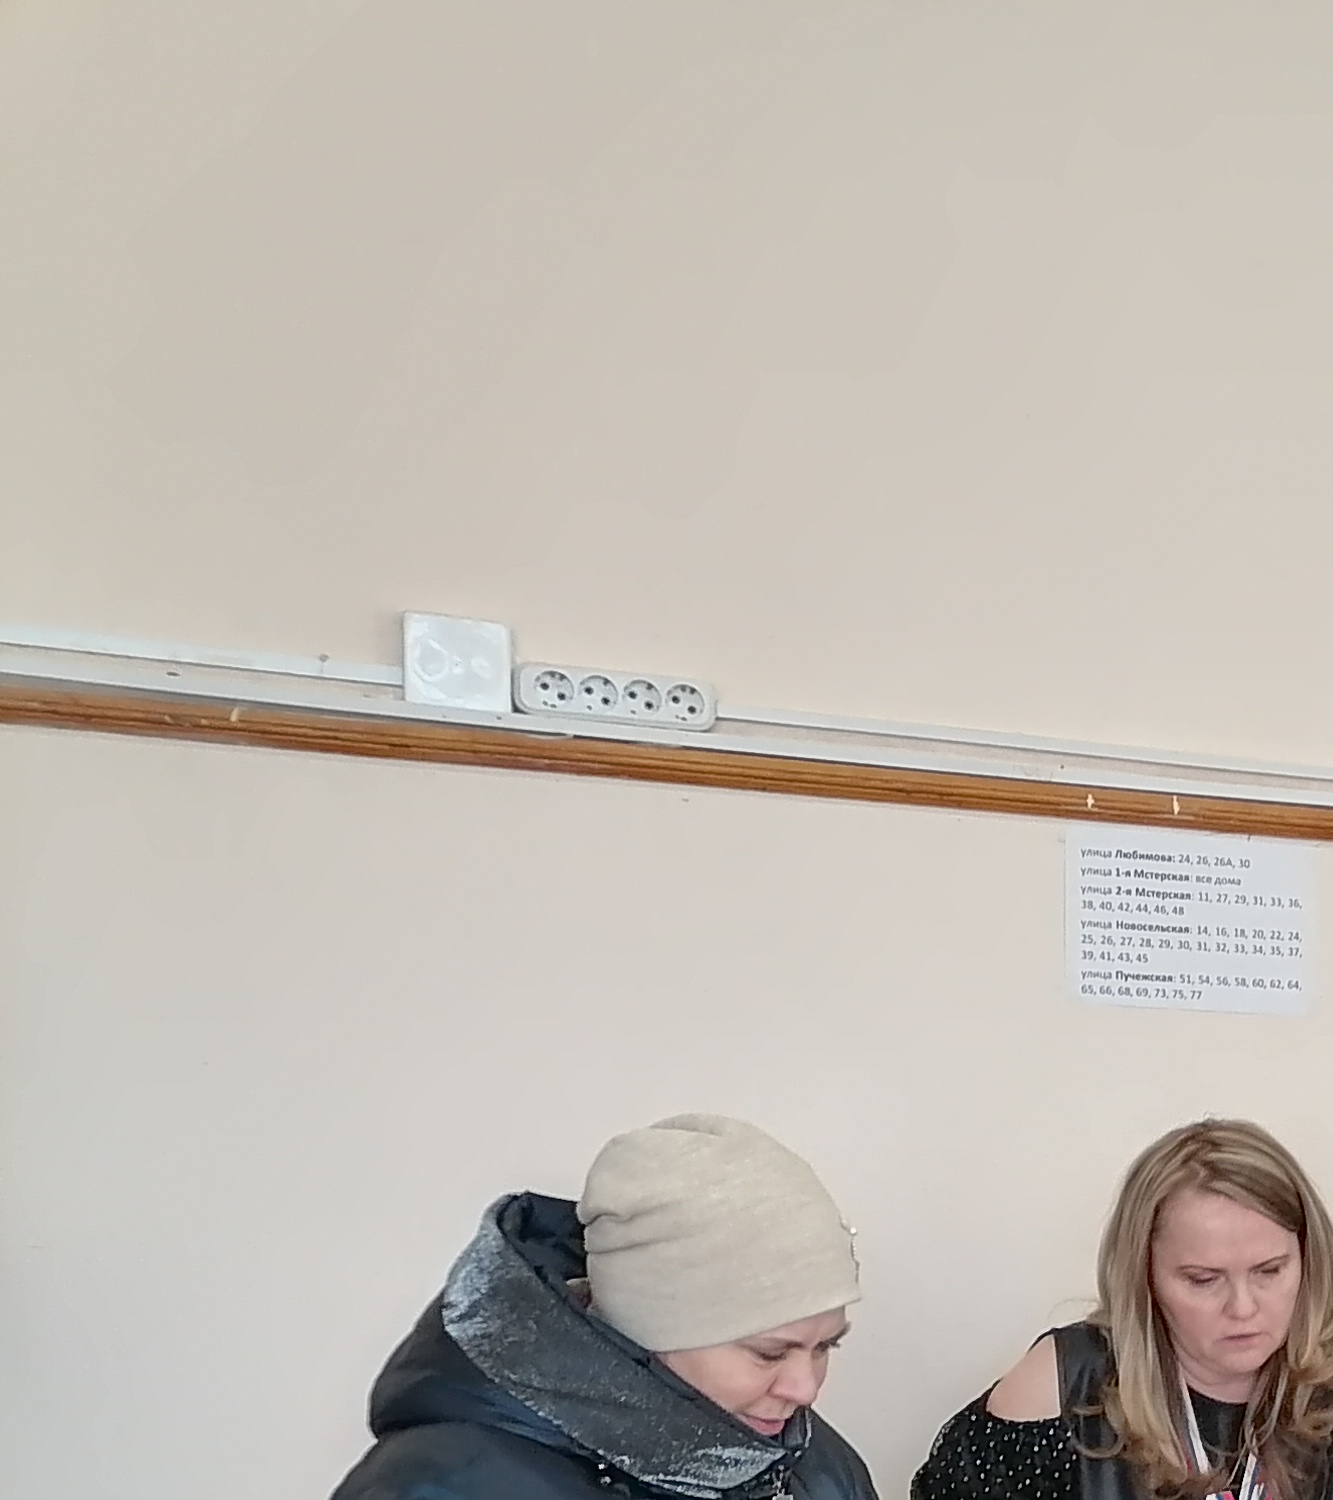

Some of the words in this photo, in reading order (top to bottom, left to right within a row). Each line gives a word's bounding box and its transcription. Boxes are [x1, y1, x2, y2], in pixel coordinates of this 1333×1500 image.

[1080, 848, 1112, 858] улица
[1080, 867, 1112, 876] улица
[1115, 867, 1131, 877] 1-я
[1195, 875, 1212, 883] все
[1214, 876, 1241, 886] дома
[1080, 885, 1112, 895] улица
[1115, 885, 1132, 896] 2-я
[1080, 920, 1112, 929] улица
[1080, 970, 1112, 980] улица
